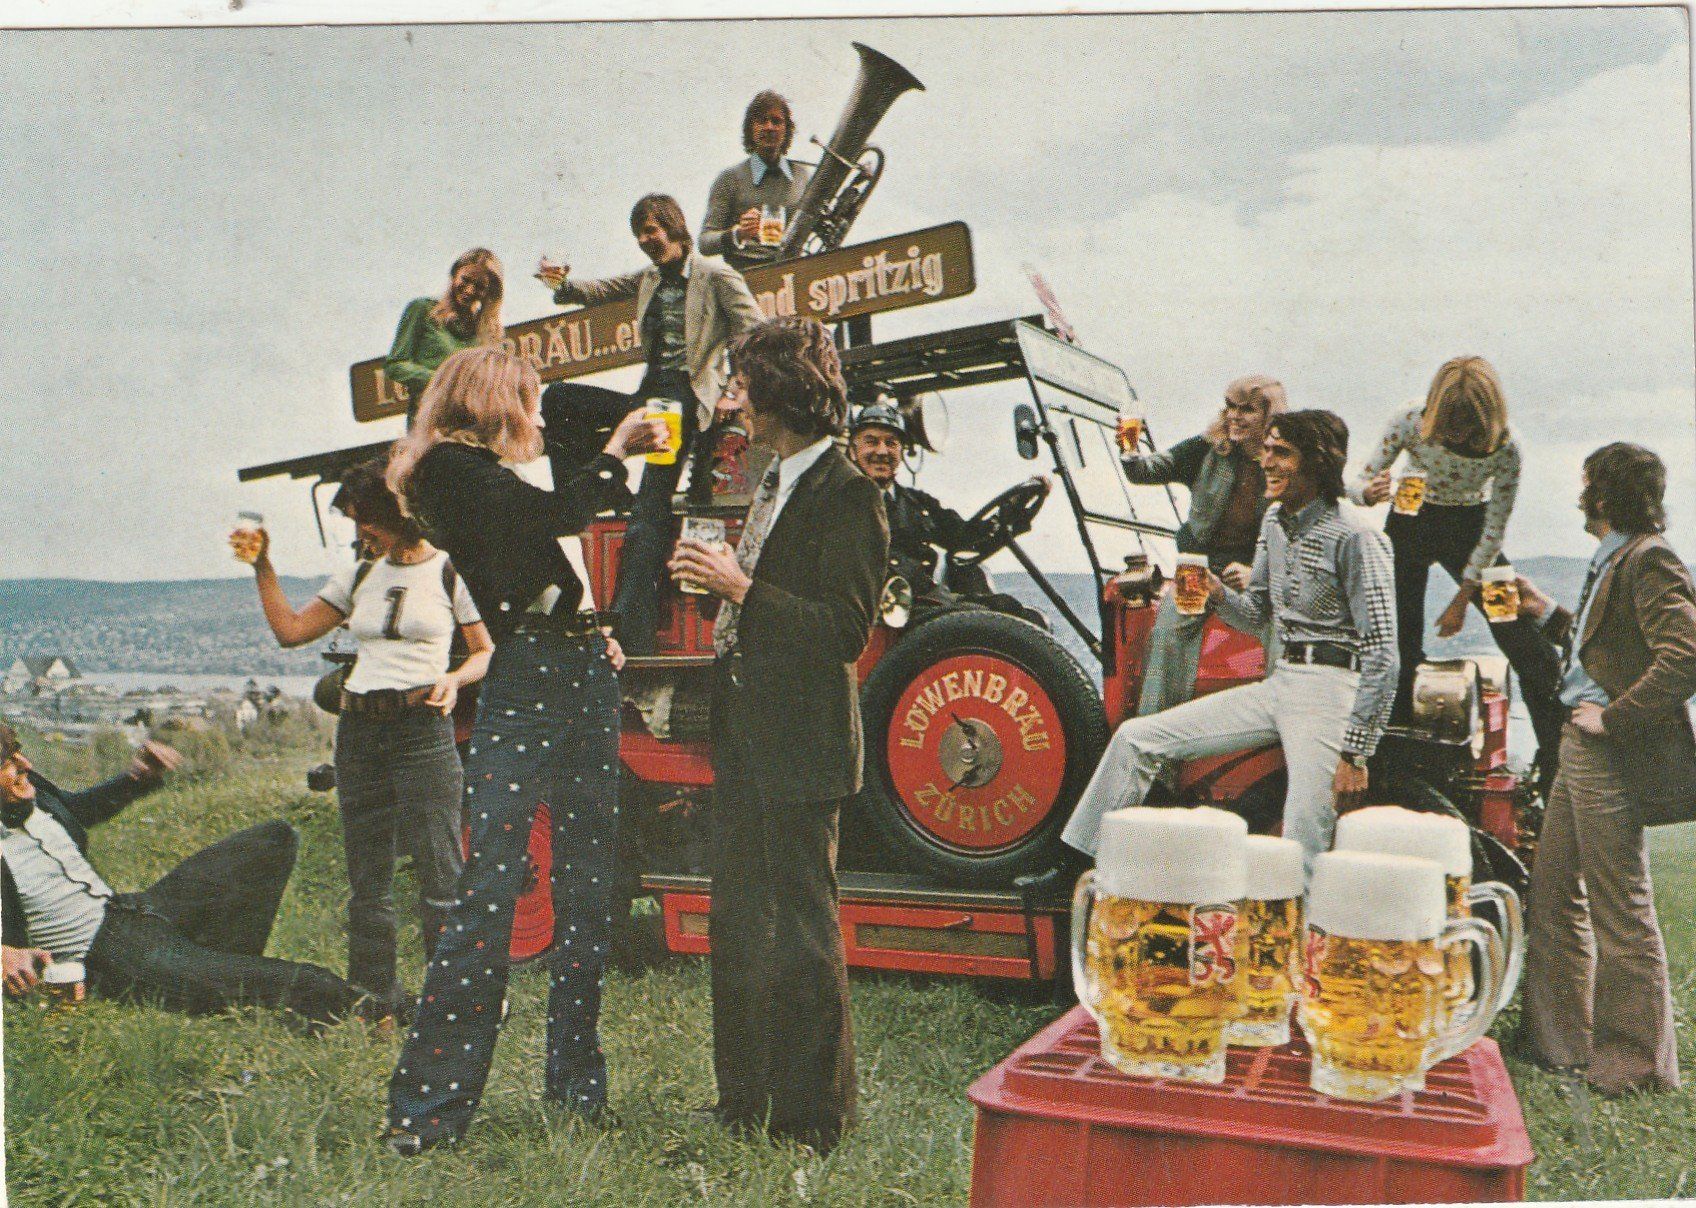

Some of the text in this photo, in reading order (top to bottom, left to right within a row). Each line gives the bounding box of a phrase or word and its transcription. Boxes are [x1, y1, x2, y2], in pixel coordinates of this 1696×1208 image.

[808, 245, 943, 316] spritzig
[900, 669, 1050, 751] LÖWENBRÄU
[914, 783, 1036, 833] ZÜRICH
